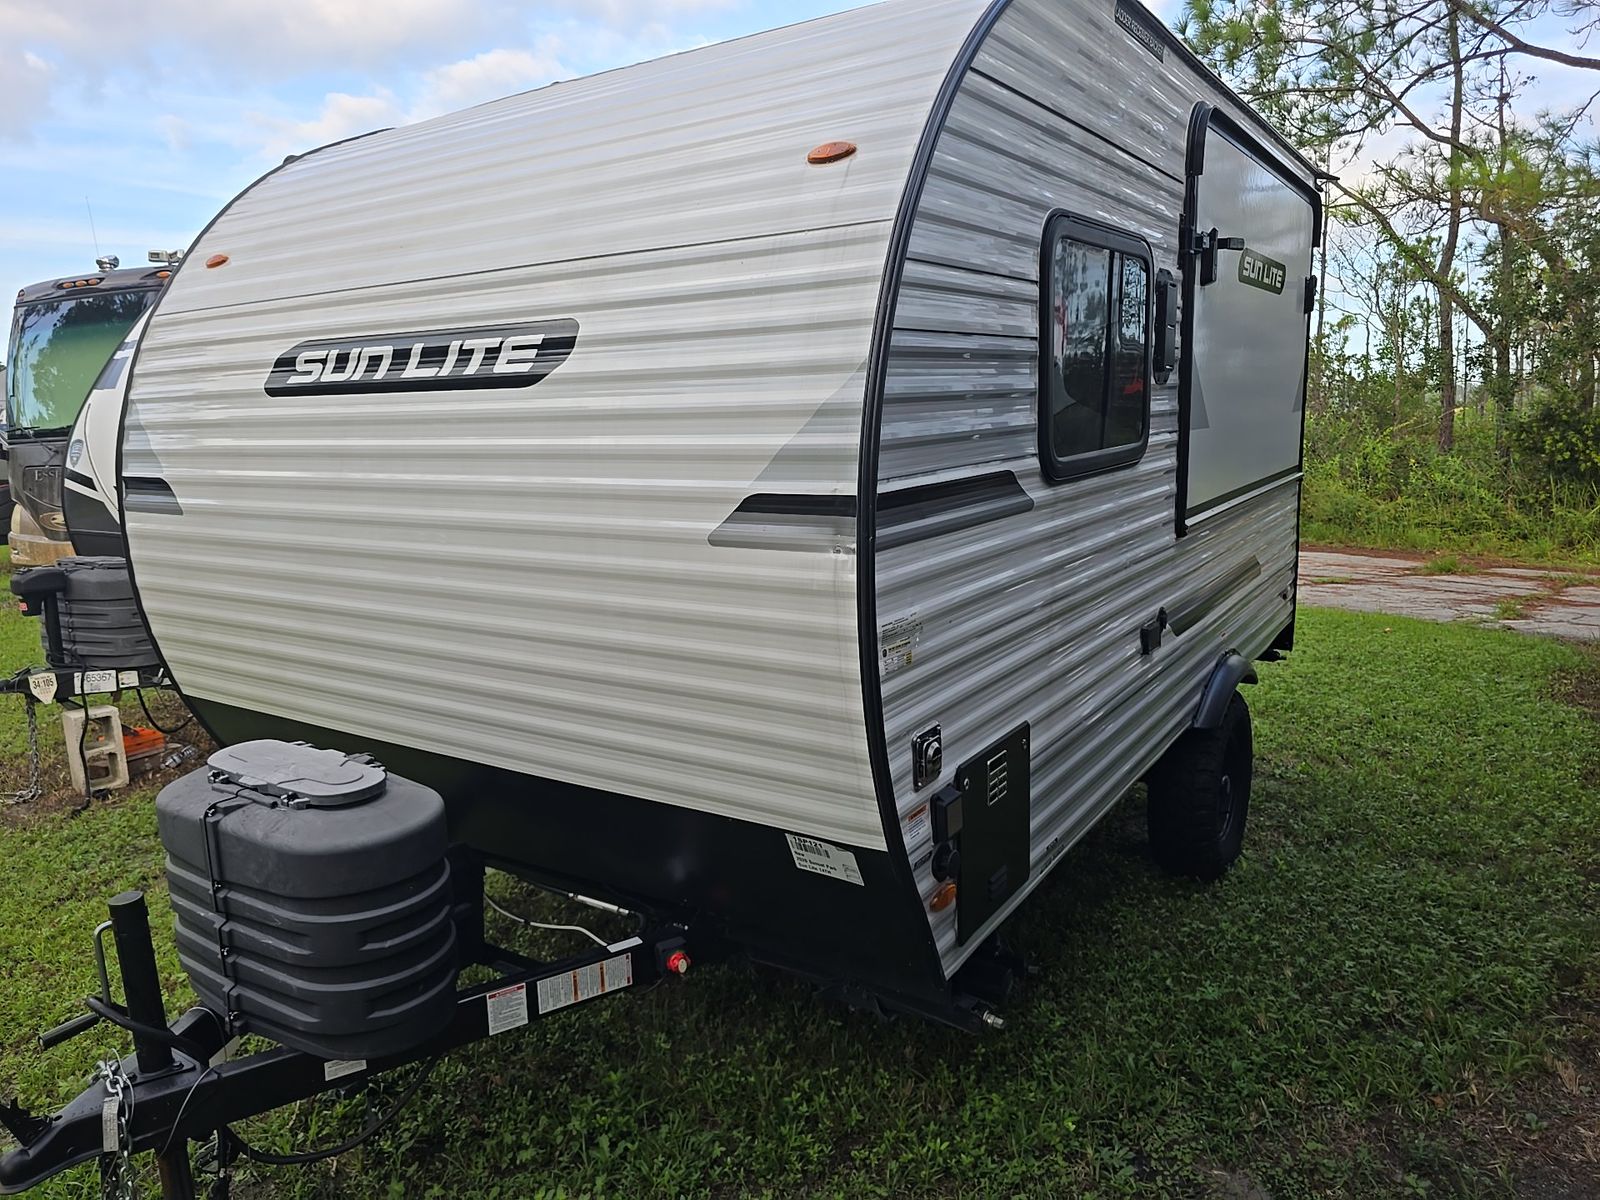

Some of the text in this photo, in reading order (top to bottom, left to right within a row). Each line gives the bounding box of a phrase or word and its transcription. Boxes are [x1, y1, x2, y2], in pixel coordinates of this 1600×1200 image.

[1242, 255, 1283, 289] SUN LITE
[286, 333, 546, 384] SUN LITE
